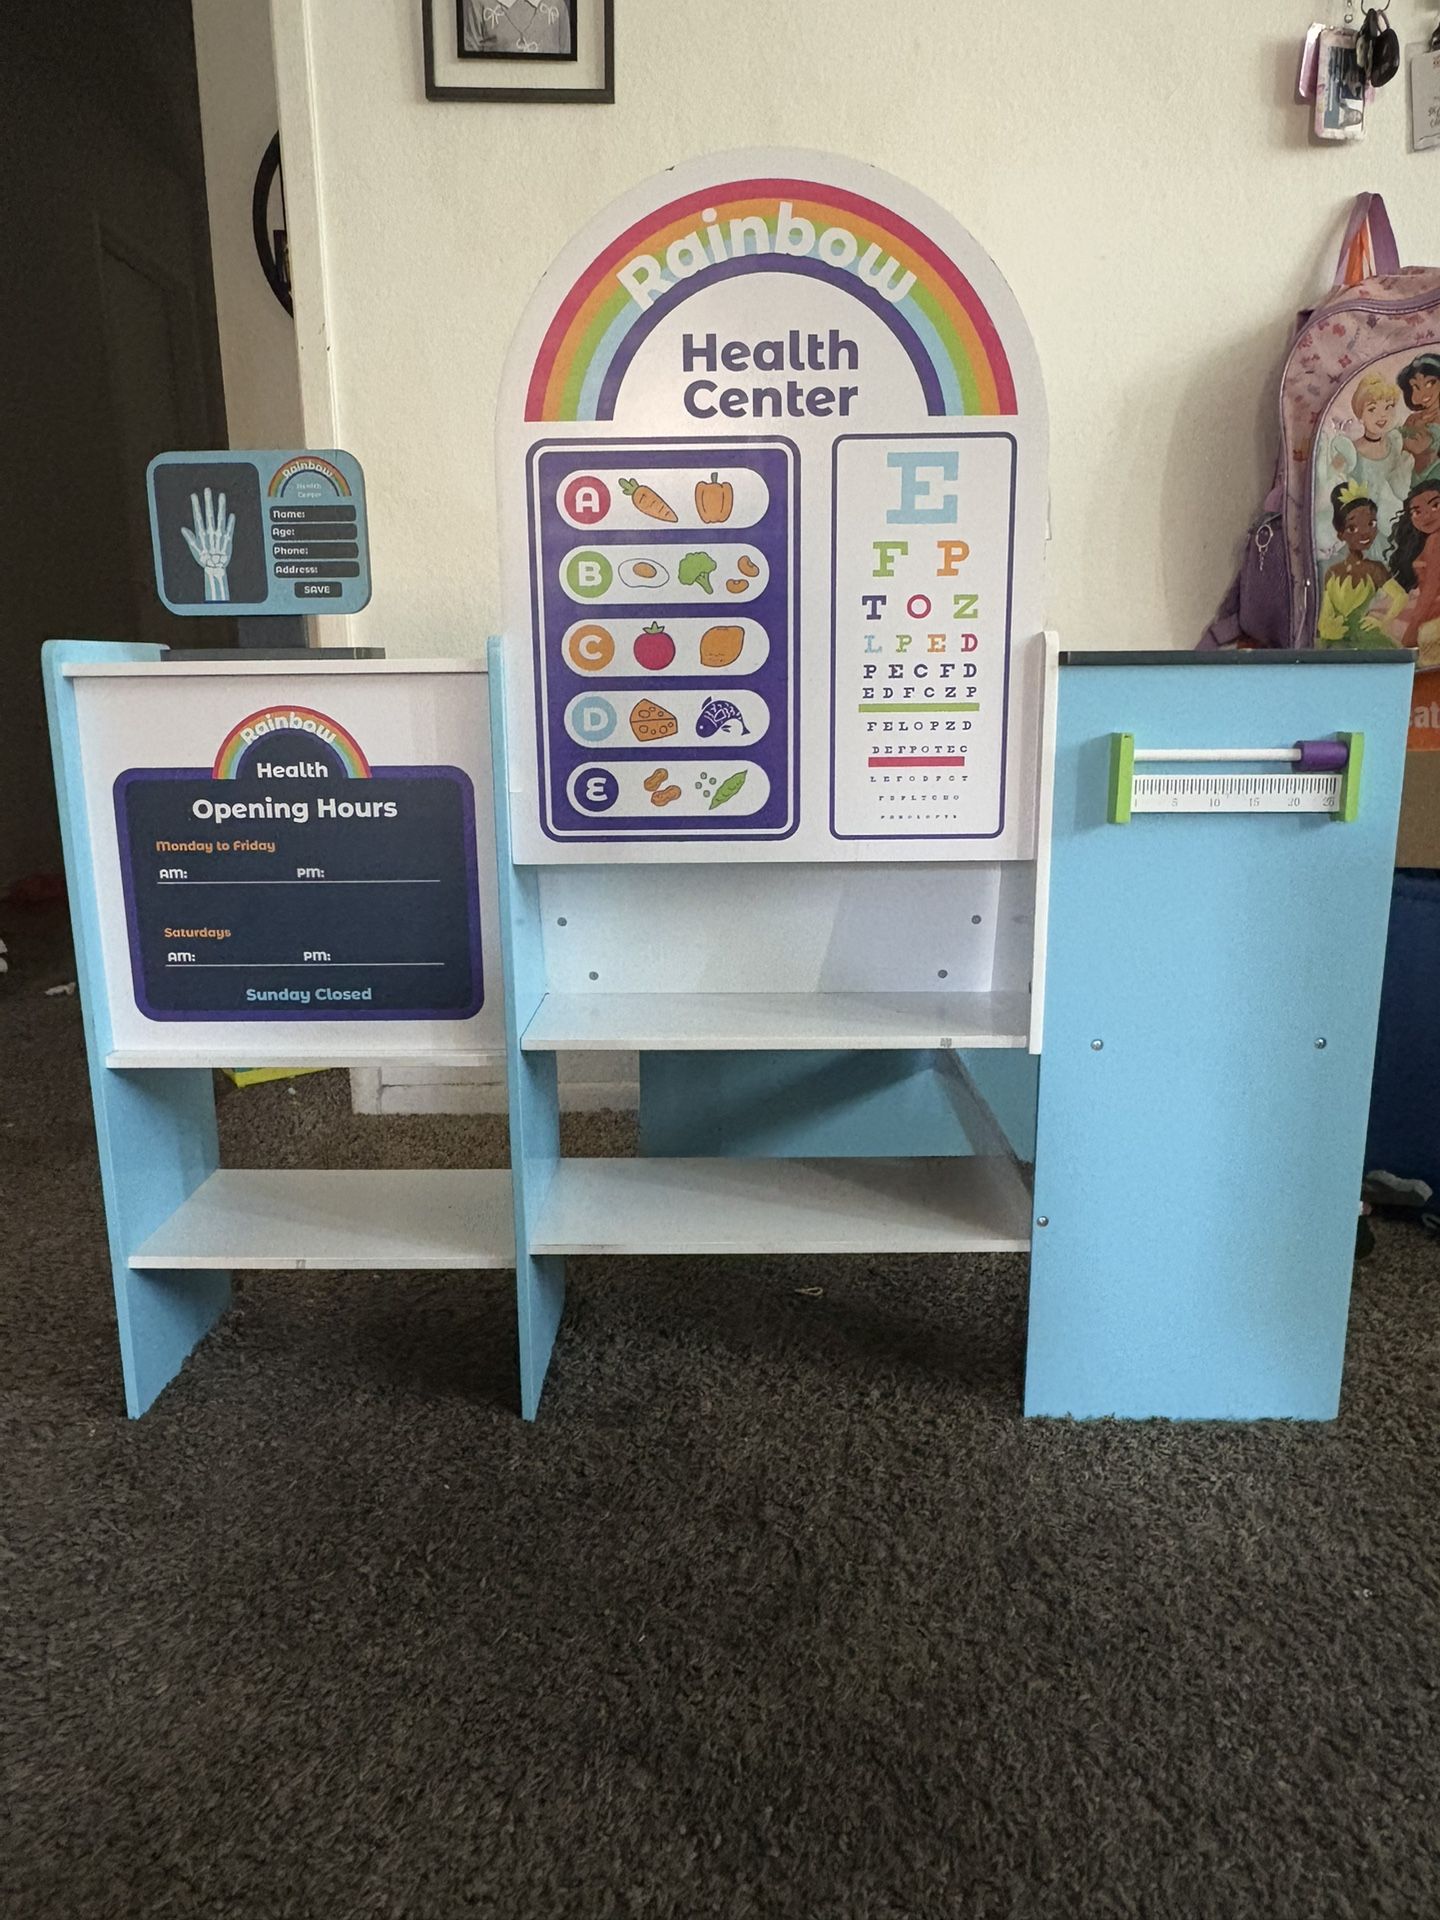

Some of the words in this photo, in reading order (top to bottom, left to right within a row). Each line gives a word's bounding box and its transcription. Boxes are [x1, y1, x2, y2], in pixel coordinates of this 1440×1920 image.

[615, 201, 918, 311] Rainbow
[681, 329, 860, 373] Health
[683, 379, 860, 419] Center
[282, 461, 333, 478] Rainbow
[886, 451, 959, 524] E
[575, 486, 600, 513] A
[272, 510, 305, 519] Name:
[272, 527, 295, 537] Age:
[273, 546, 308, 555] Phone:
[872, 541, 909, 577] F
[936, 540, 970, 577] P
[275, 565, 318, 574] Address:
[577, 561, 602, 587] B
[304, 585, 330, 594] SAVE
[578, 634, 602, 661] C
[585, 708, 609, 732] D
[240, 712, 337, 746] Rainbow
[256, 761, 329, 779] Health
[191, 797, 310, 824] Opening
[317, 798, 398, 820] Hours
[1209, 798, 1221, 807] 10
[156, 840, 214, 854] Monday
[216, 840, 230, 852] to
[233, 840, 276, 853] Friday
[159, 868, 188, 879] AM:
[297, 867, 325, 878] PM:
[164, 927, 231, 939] Saturdays
[168, 951, 196, 962] AM:
[304, 950, 331, 961] PM:
[246, 988, 311, 1004] Sunday
[315, 988, 372, 1001] Closed
